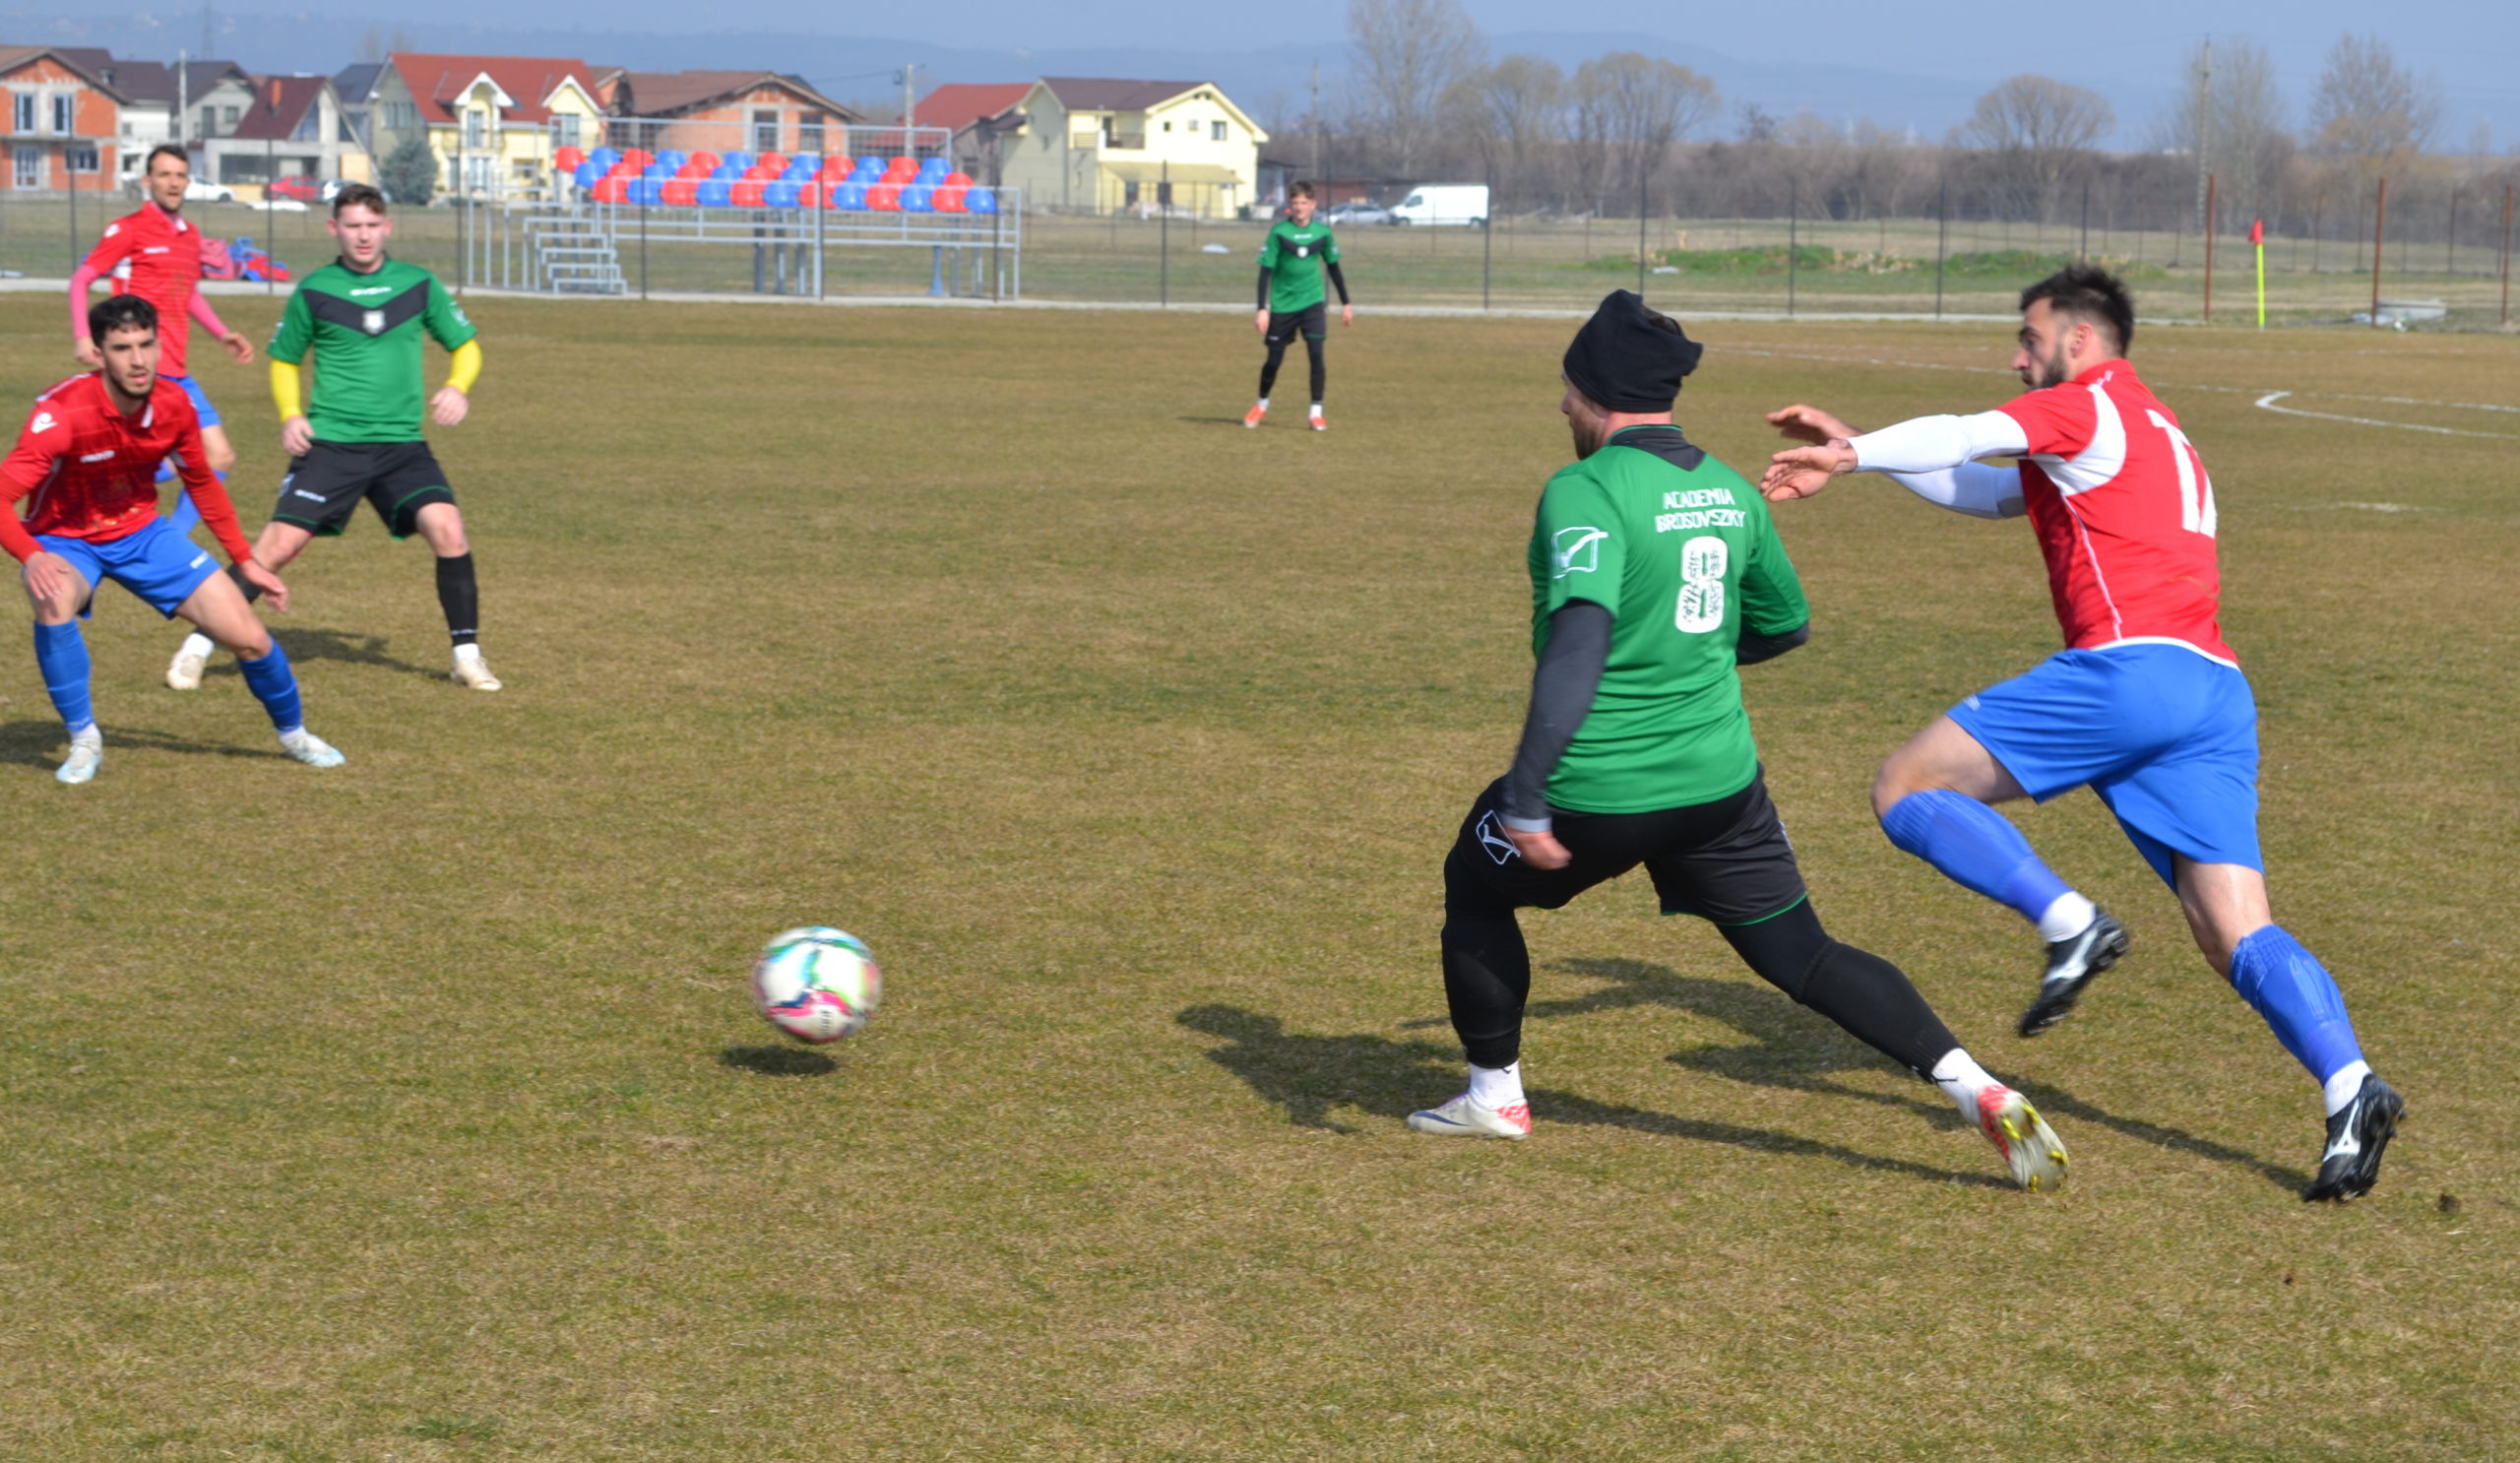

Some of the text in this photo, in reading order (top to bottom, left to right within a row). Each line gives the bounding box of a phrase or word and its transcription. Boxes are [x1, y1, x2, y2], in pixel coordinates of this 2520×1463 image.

[1663, 488, 1735, 510] ACADEMIA
[1655, 509, 1745, 533] BROSOVSZKY
[1675, 536, 1728, 633] 8
